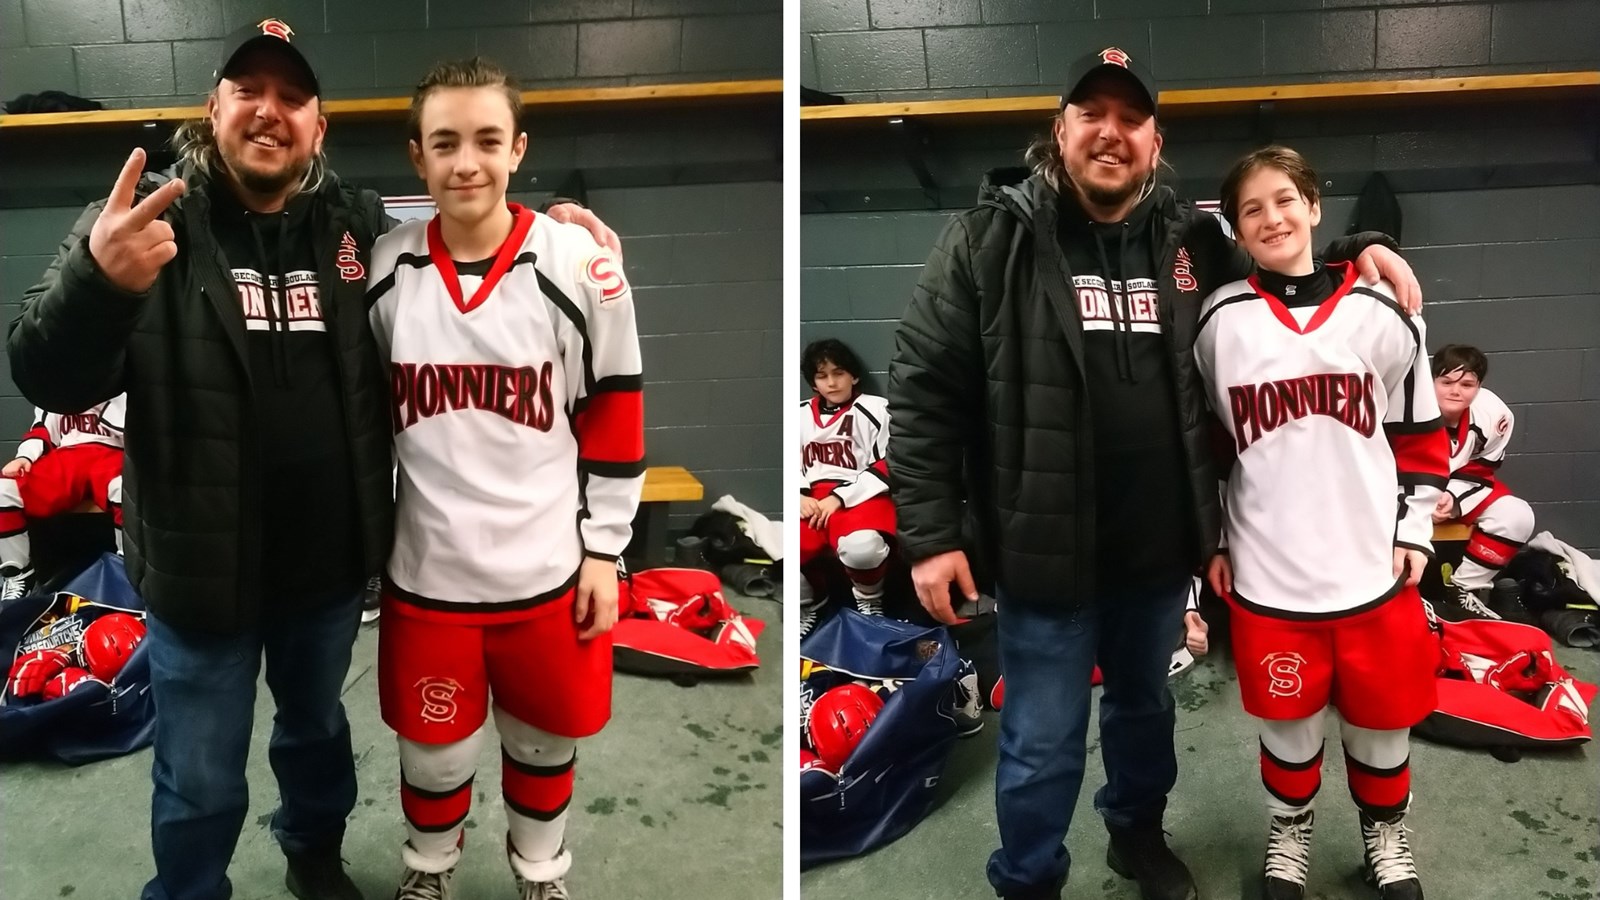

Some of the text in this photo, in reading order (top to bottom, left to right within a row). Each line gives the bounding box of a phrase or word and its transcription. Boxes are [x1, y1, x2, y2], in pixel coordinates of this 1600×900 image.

[586, 254, 628, 304] S
[391, 360, 555, 436] PIONNIERS
[1227, 371, 1377, 455] PIONNIERS
[836, 414, 854, 437] A
[1268, 657, 1303, 697] S
[420, 682, 458, 723] S
